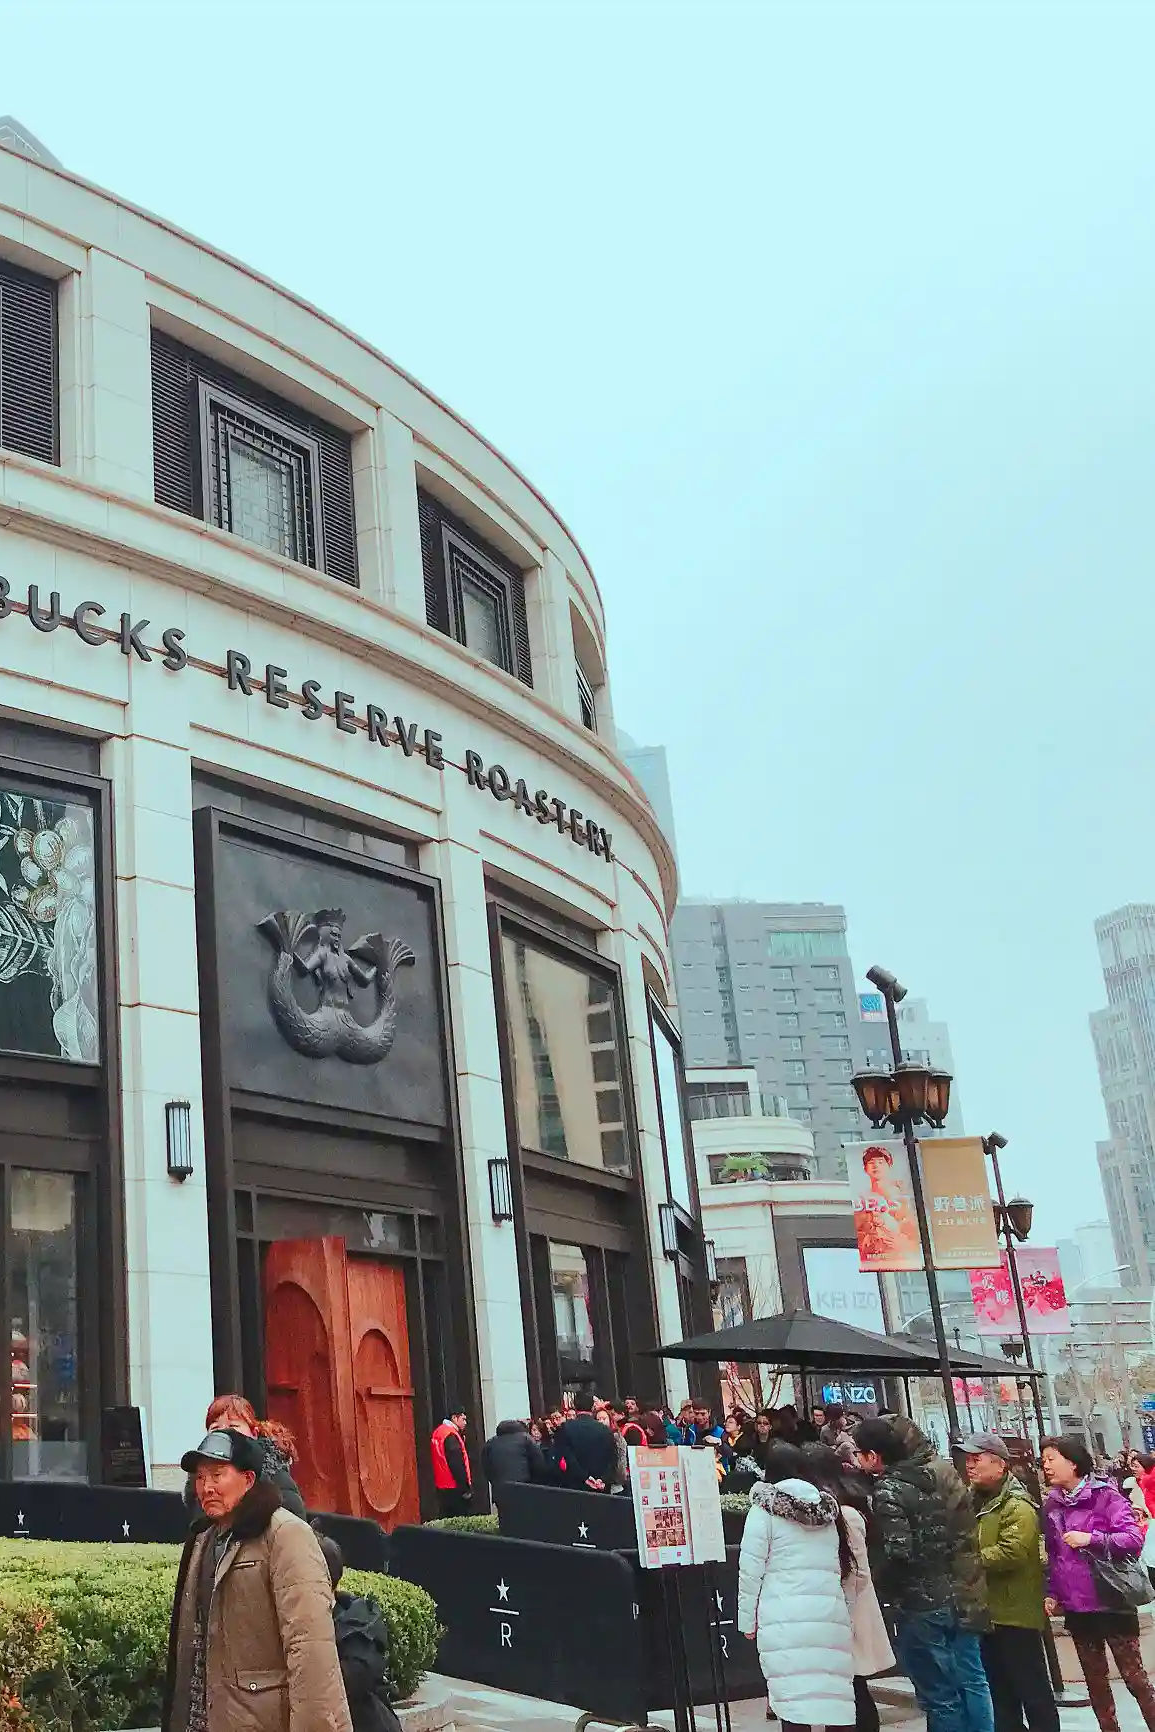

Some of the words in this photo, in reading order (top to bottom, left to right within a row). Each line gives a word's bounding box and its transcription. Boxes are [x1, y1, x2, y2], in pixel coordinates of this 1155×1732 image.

[227, 649, 445, 770] RESERVE
[465, 750, 614, 863] ROASTERY
[816, 1291, 879, 1309] KENZO
[822, 1386, 877, 1404] KENZO
[500, 1622, 513, 1648] R
